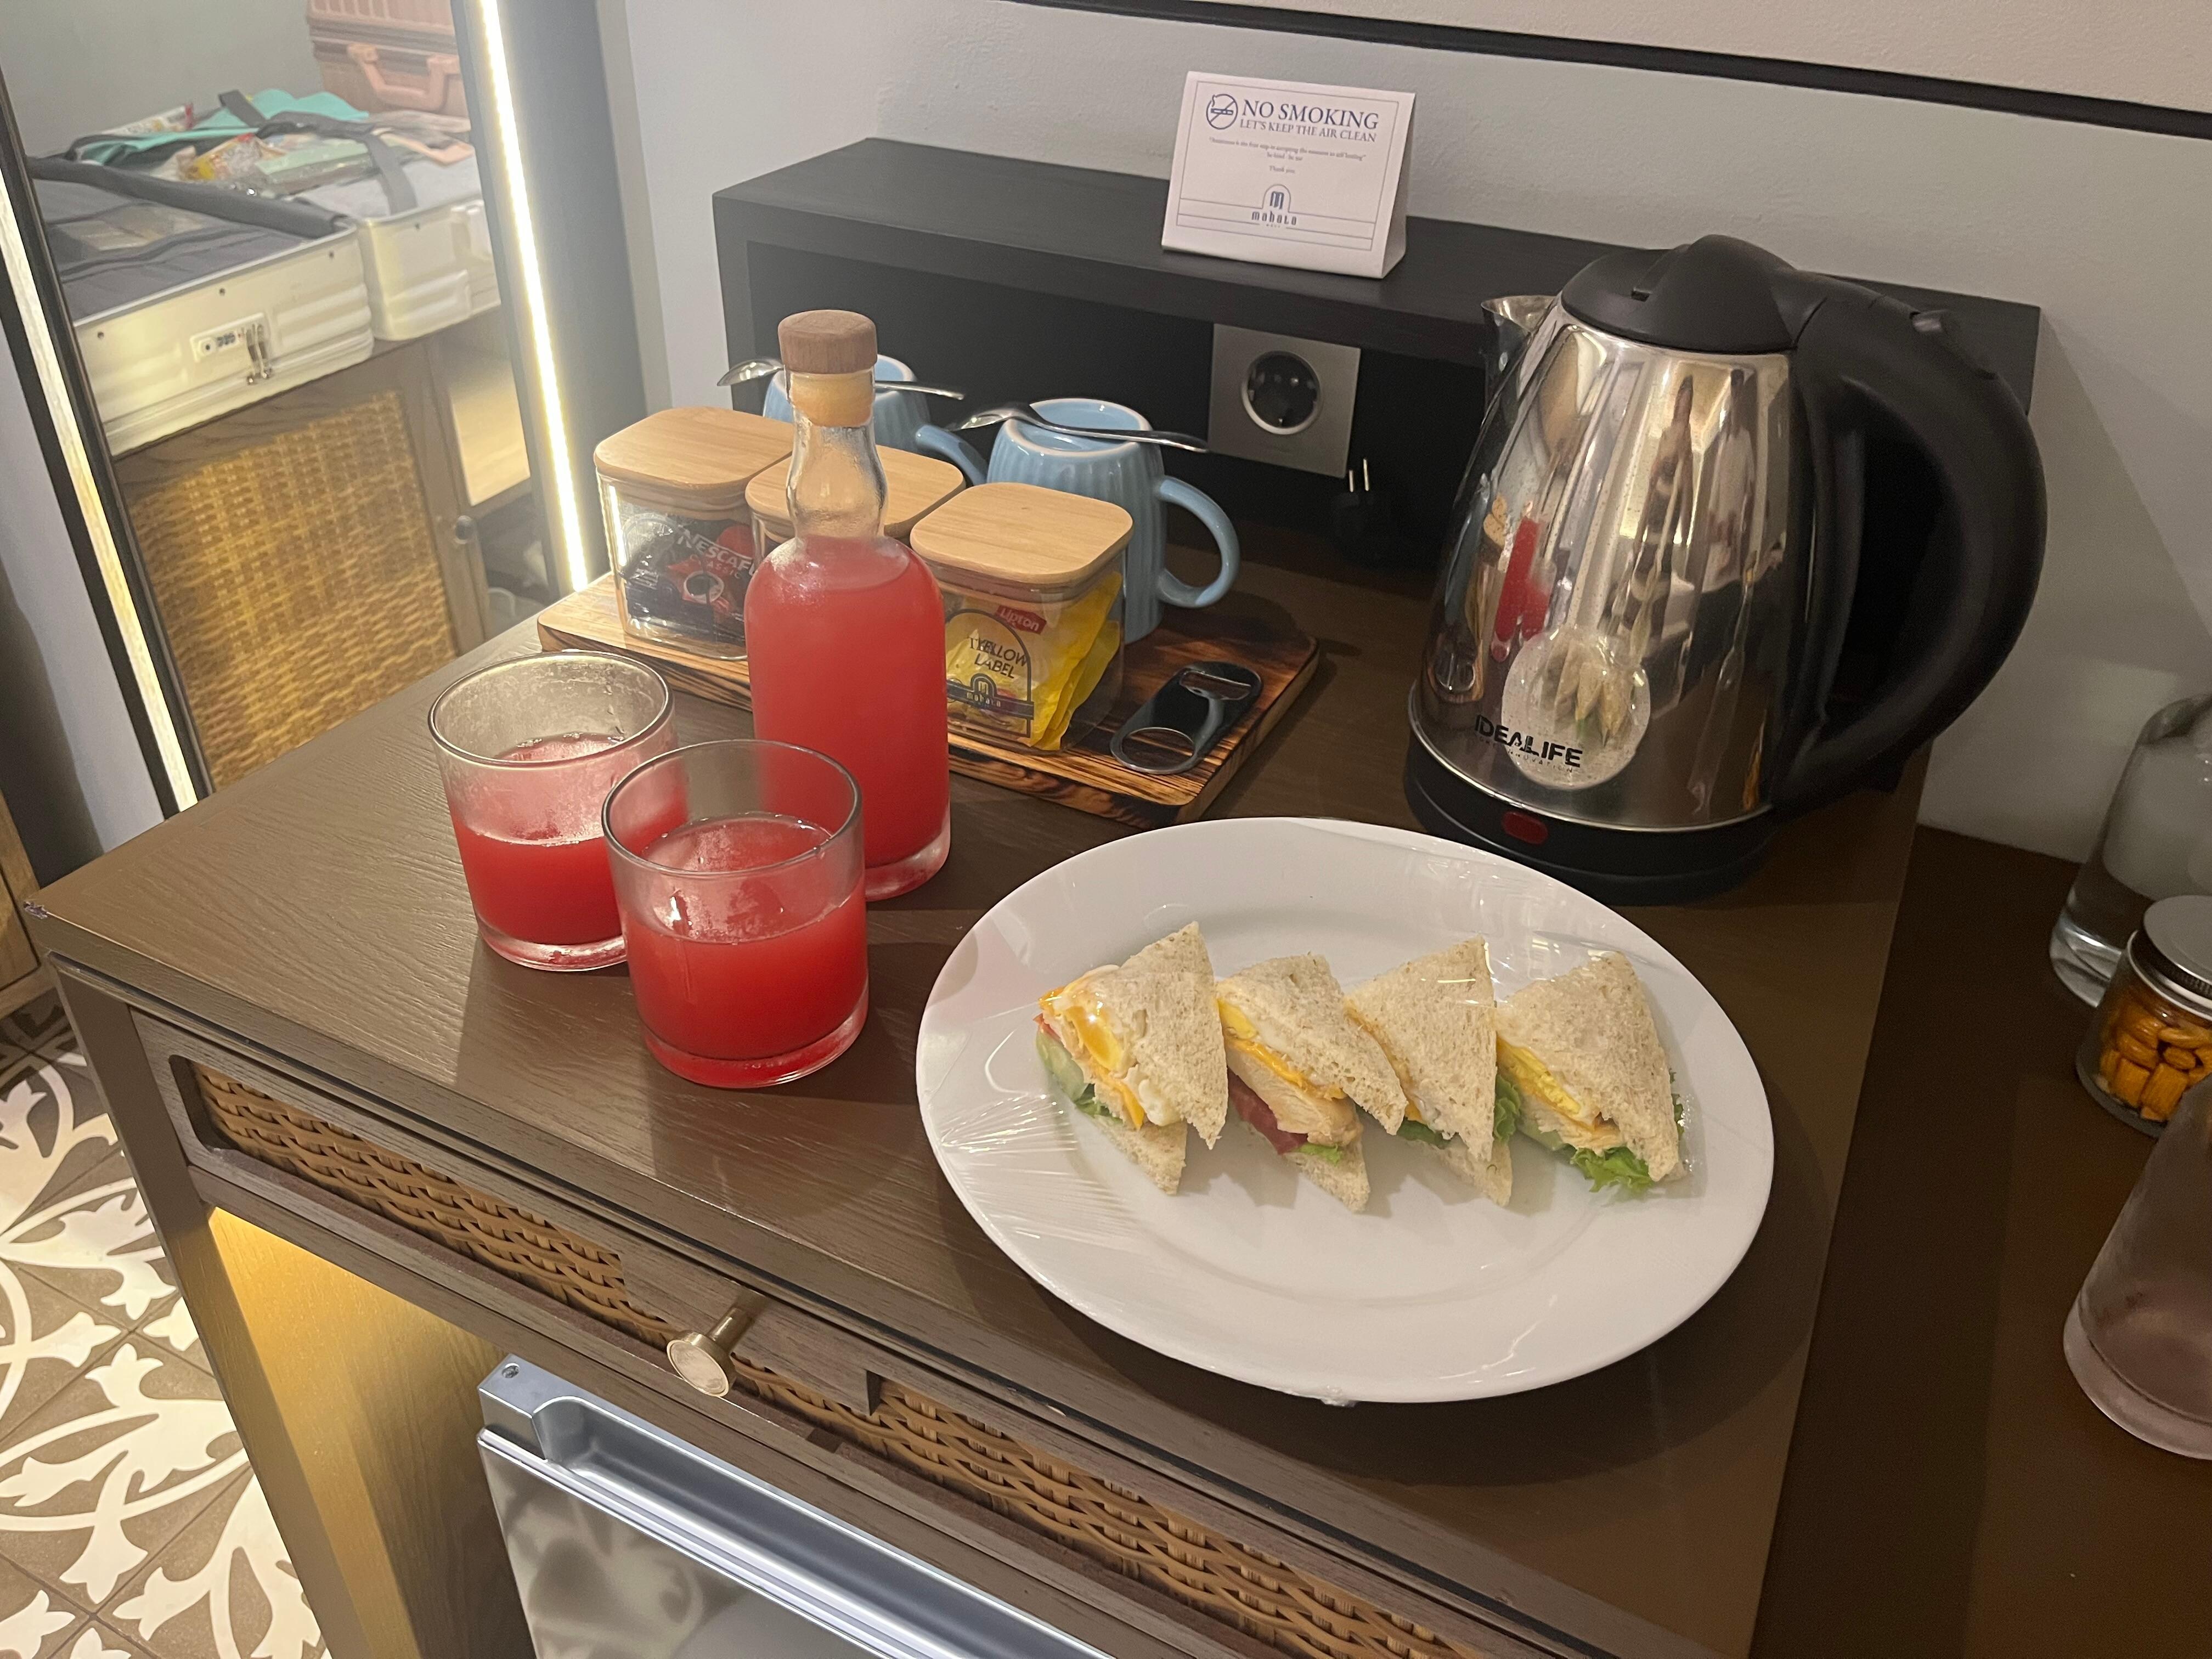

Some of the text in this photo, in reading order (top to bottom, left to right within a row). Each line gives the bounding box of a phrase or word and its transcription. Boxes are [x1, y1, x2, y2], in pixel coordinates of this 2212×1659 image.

[1242, 99, 1379, 129] NO SMOKING
[1240, 119, 1377, 142] LET'S KEEP THE AIR CLEAN
[1000, 607, 1040, 631] Lipton
[974, 653, 1014, 679] LABEL
[1474, 714, 1583, 768] IDEALIFE
